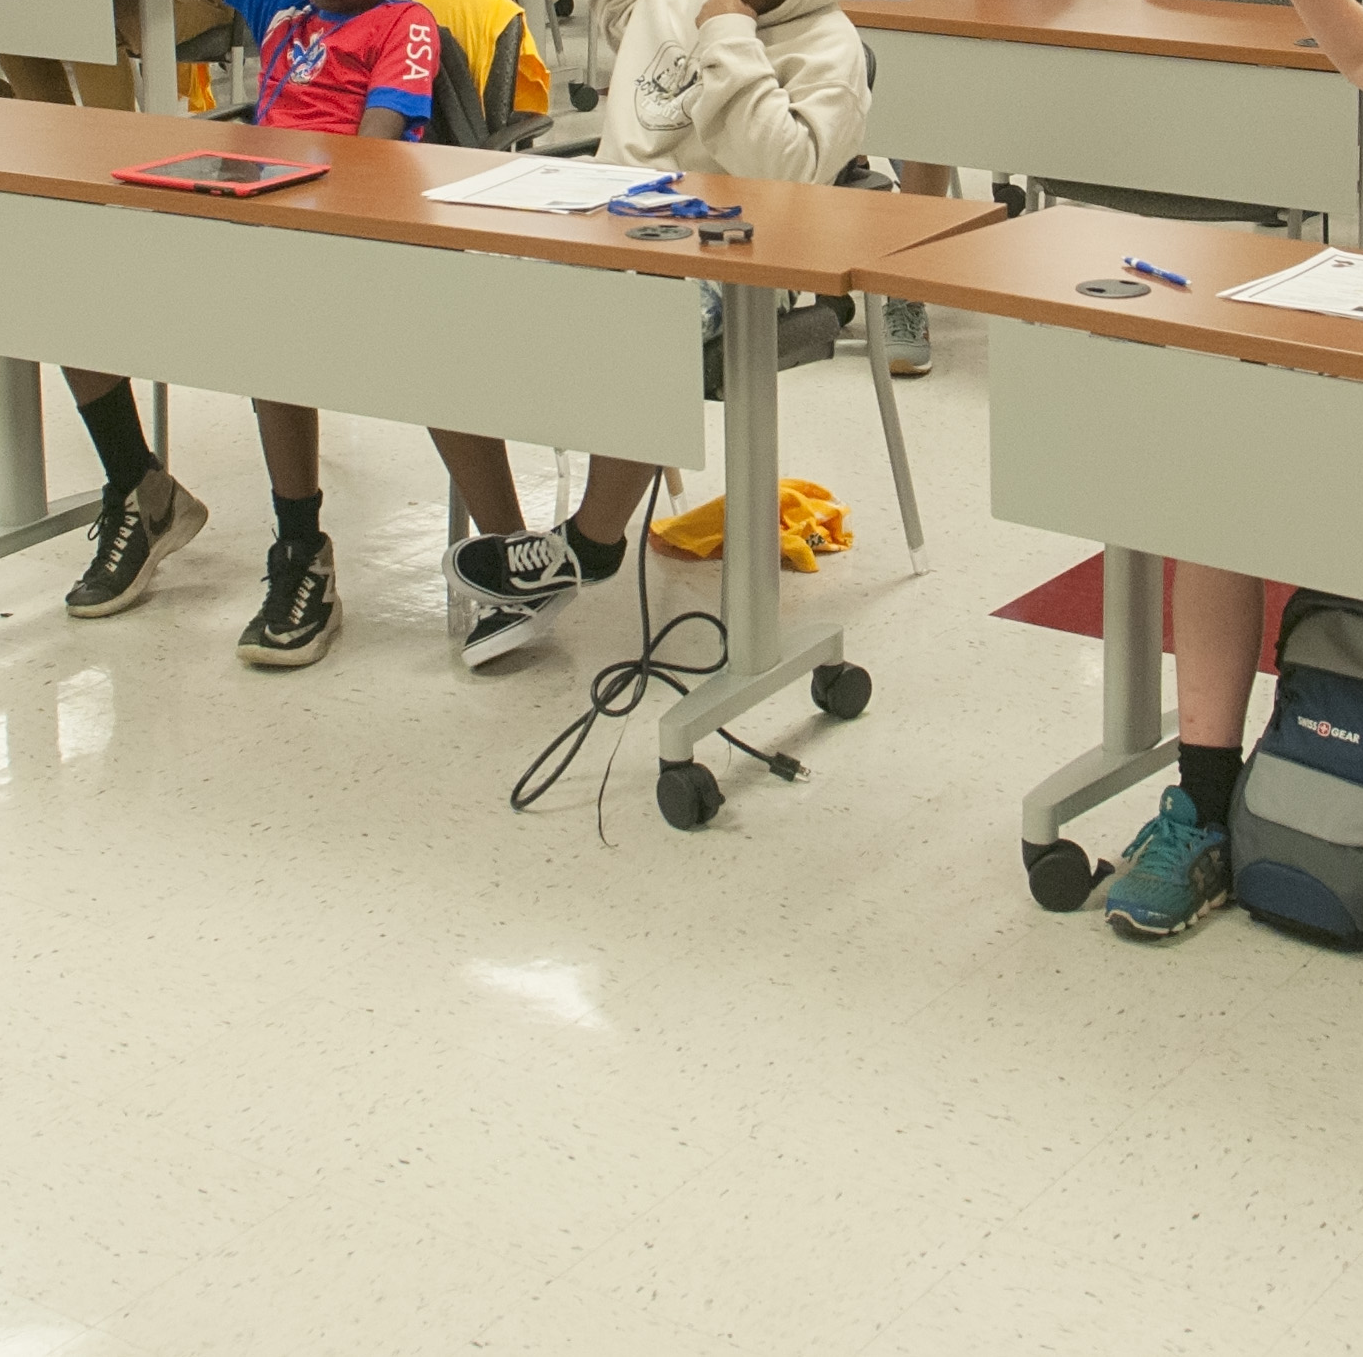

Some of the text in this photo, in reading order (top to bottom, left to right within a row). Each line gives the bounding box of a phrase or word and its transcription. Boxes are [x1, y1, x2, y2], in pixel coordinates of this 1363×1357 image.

[402, 23, 432, 80] BSA
[1297, 715, 1360, 744] SWISS GEAR
